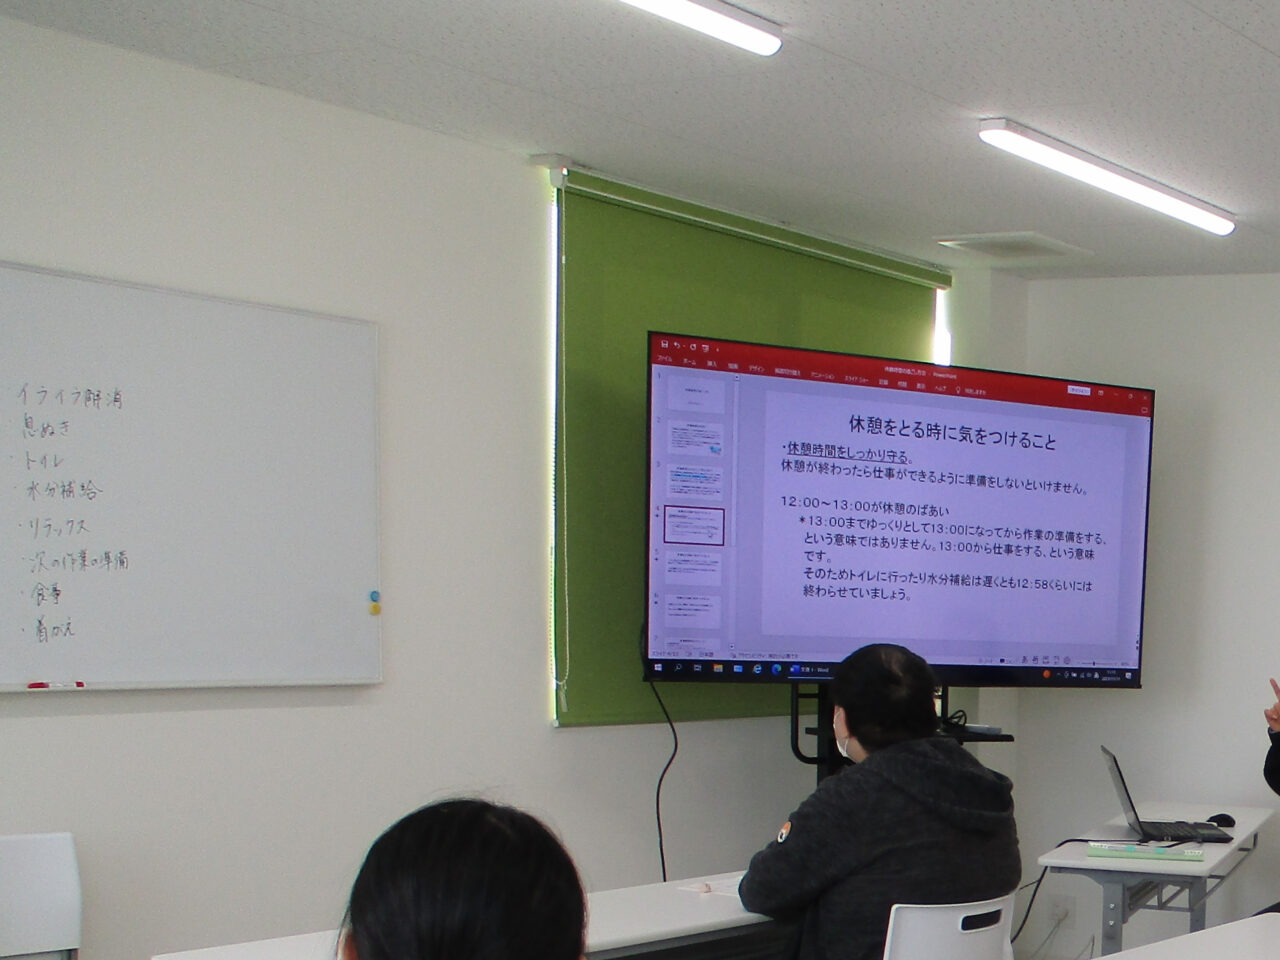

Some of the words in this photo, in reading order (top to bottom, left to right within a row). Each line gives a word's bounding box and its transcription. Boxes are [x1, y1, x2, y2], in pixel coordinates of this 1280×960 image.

[849, 414, 1057, 451] 休憩をとる時に気をつけること
[781, 458, 1088, 496] 休憩が終わったら仕事ができるように準備をしないといけません。
[803, 550, 832, 564] です。
[803, 567, 1093, 592] そのためトイレに行ったり水分補給は遅くとも12:58くらいには
[802, 584, 912, 602] 終わらせていましょう。
